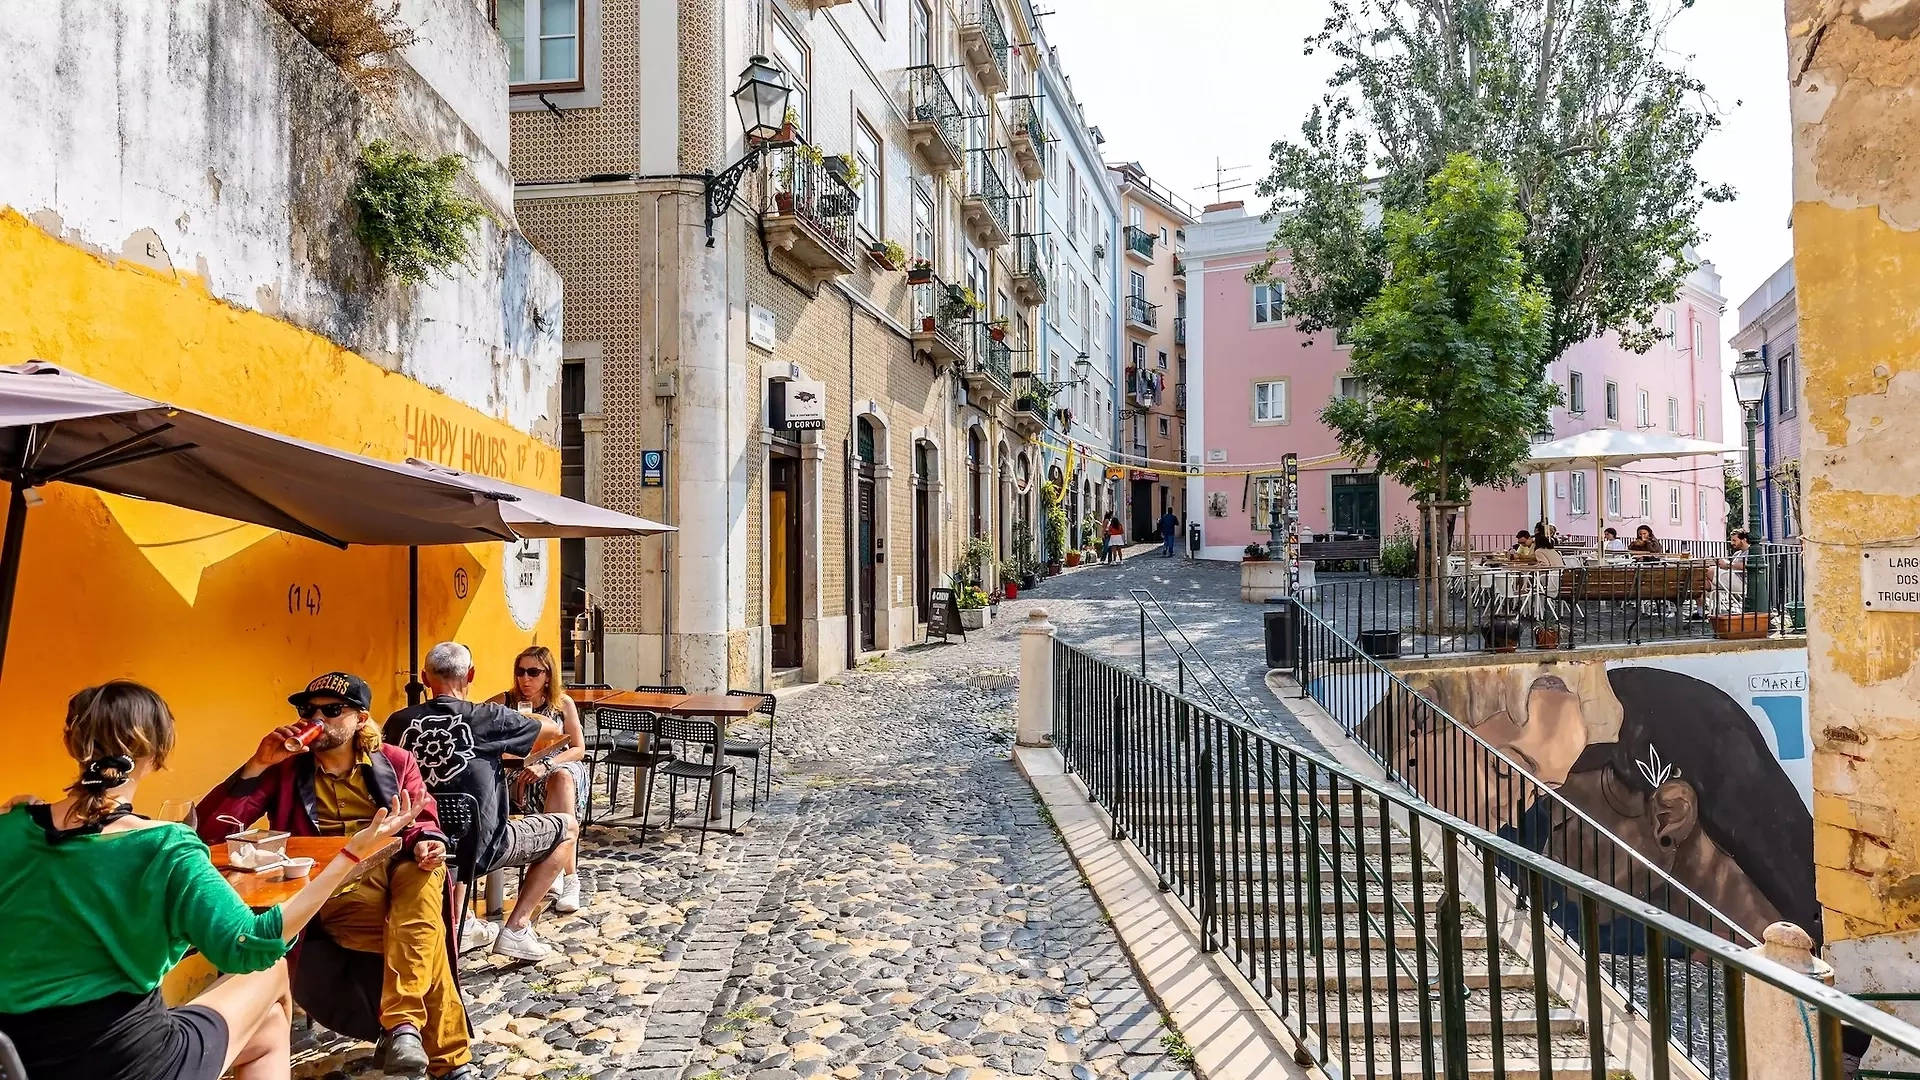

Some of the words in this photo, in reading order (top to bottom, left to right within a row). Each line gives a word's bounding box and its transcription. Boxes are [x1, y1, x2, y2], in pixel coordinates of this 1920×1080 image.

[786, 421, 792, 429] O
[794, 420, 821, 429] CORVO
[404, 404, 458, 467] HAPPY
[462, 427, 507, 479] HOURS
[1889, 557, 1920, 568] LARG
[1896, 574, 1919, 585] DOS
[1878, 591, 1920, 602] TRIGUEI
